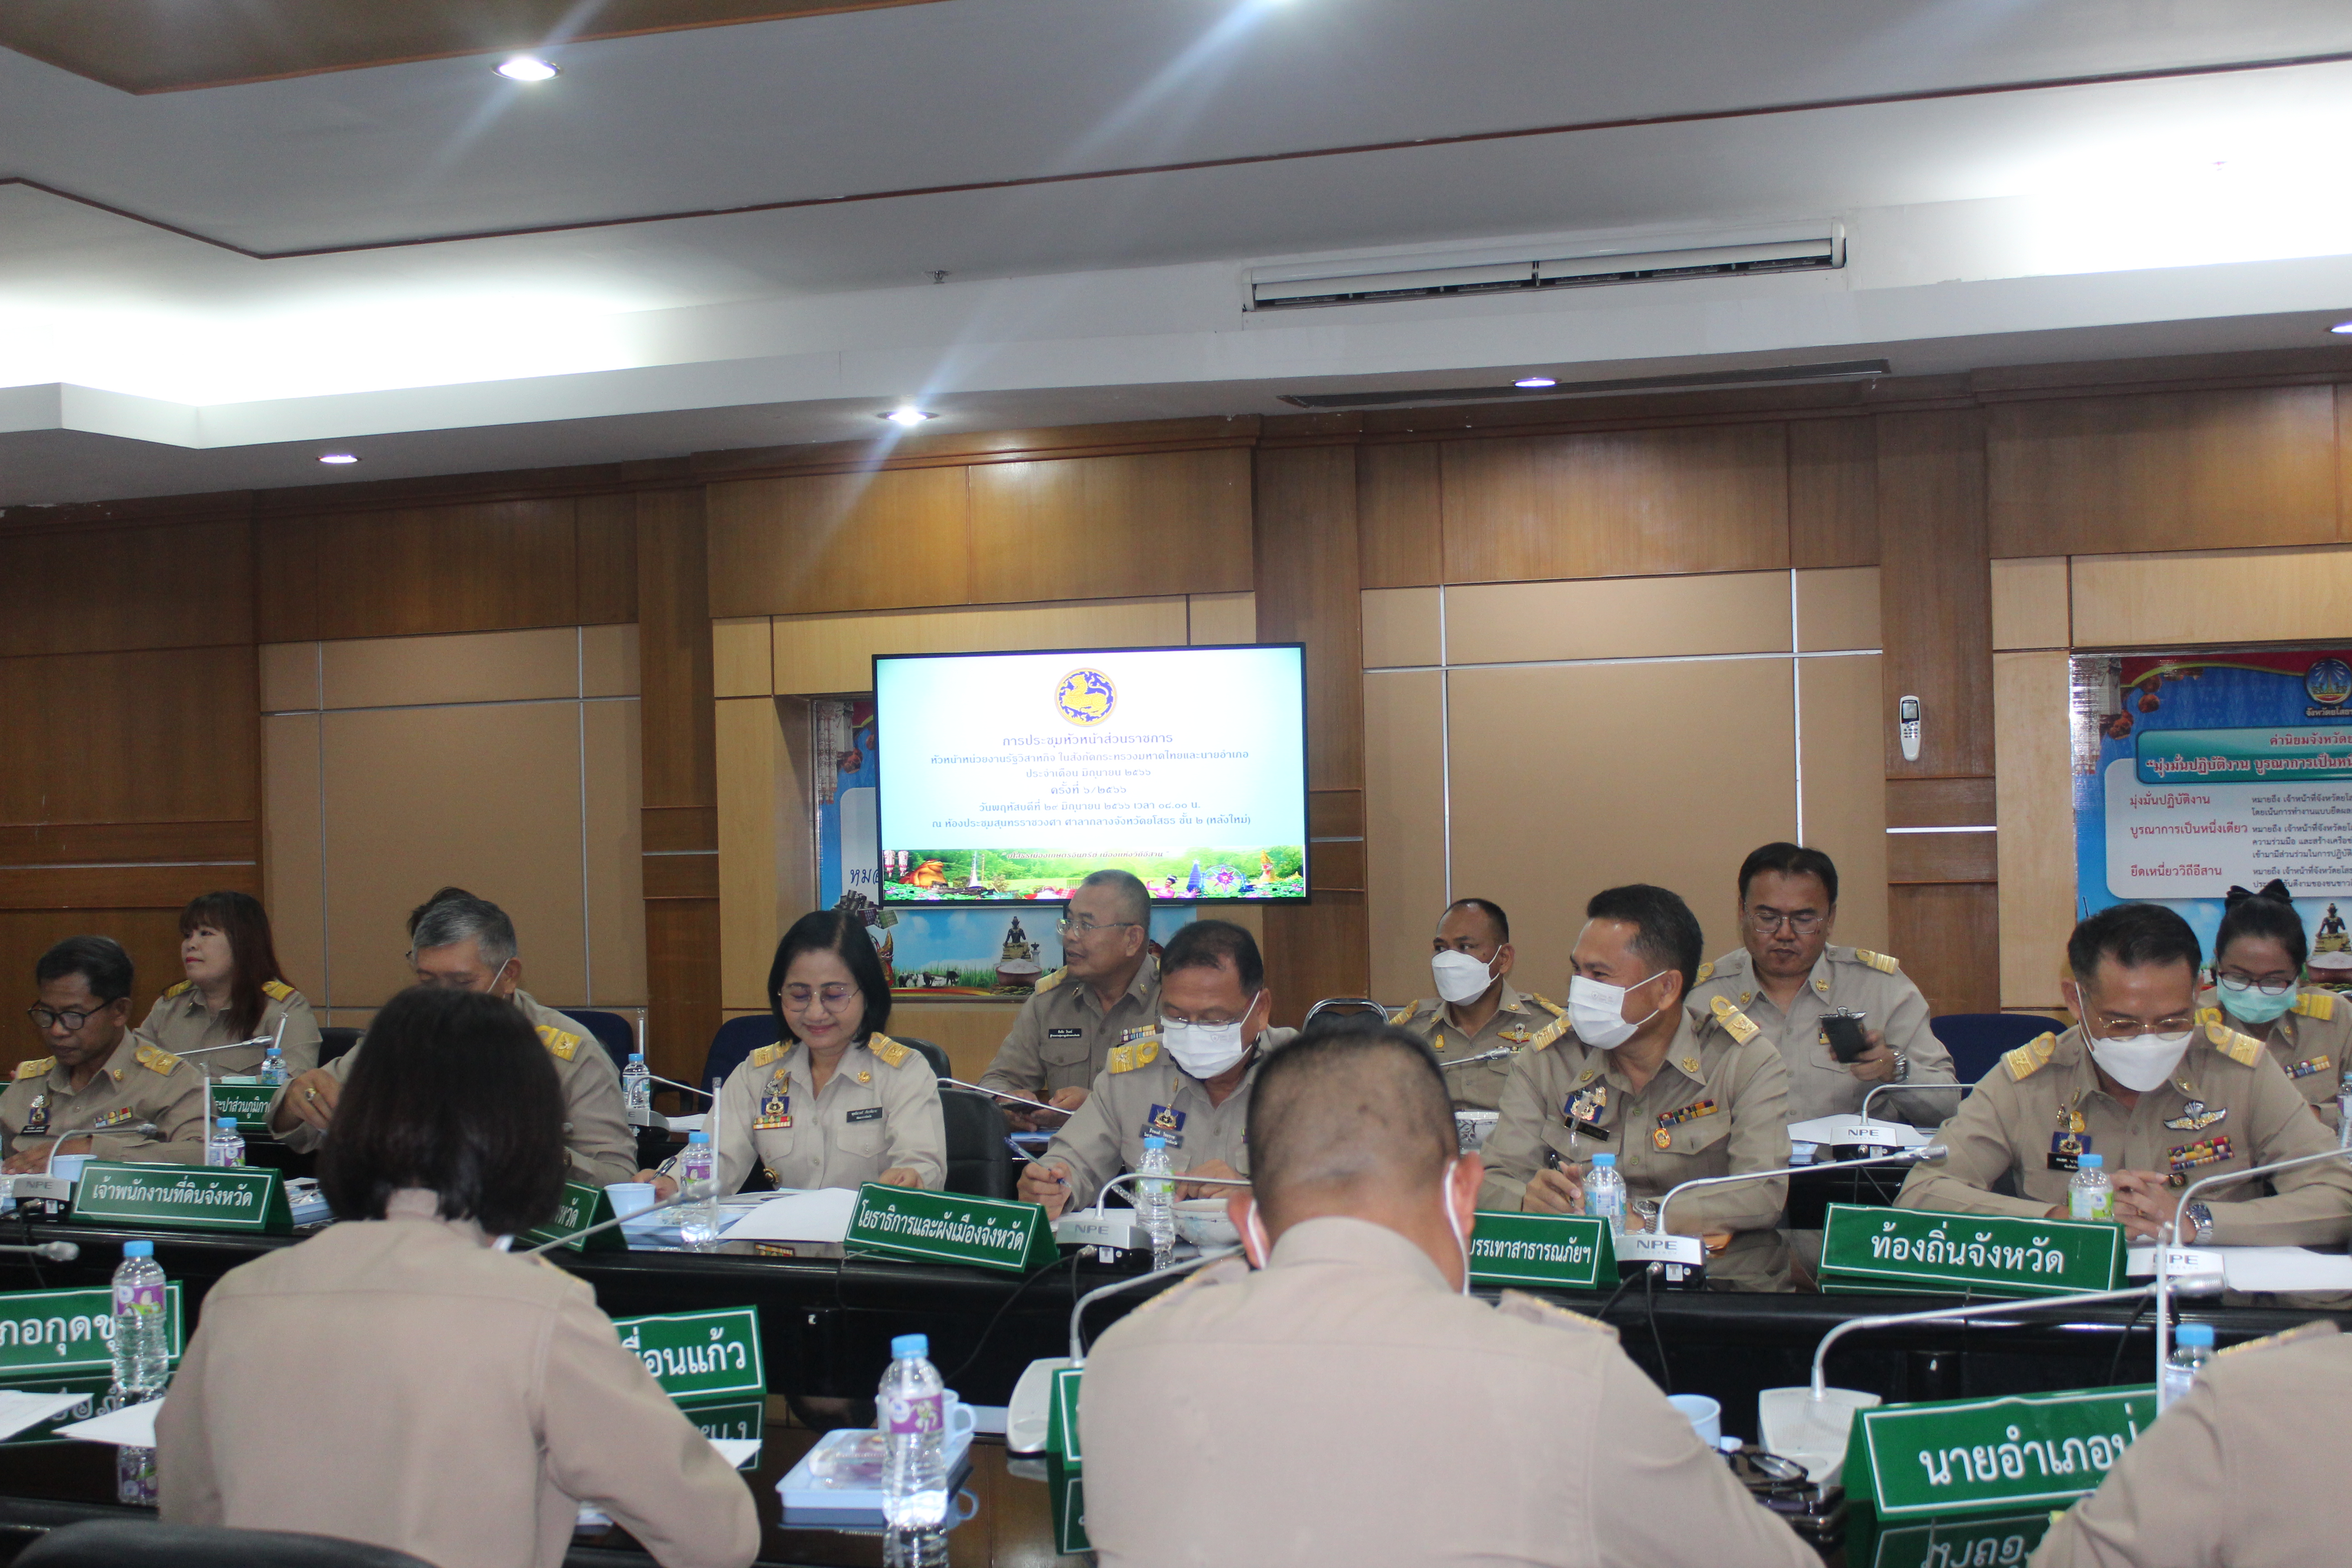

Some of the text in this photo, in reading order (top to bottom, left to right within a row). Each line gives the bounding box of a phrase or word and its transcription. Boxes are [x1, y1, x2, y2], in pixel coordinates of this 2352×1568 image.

[1003, 732, 1173, 748] การประชุมหัวหน้าส่วนราชการ
[931, 754, 1055, 764] หัวหน้าหน่วยงานรัฐวิสาหกิจ
[1026, 768, 1078, 778] ประจำเดือน
[1082, 768, 1121, 779] มิถุนายน
[1051, 781, 1079, 794] ครั้งที่
[2130, 791, 2210, 809] มุ่งมั่นปฏิบัติงาน
[2252, 794, 2280, 803] หมายถึง
[979, 799, 1040, 813] วันพฤหัสบดีที่
[1062, 802, 1100, 813] มิถุนายน
[1065, 815, 1176, 826] ศาลากลางจังหวัดยโสธร
[1179, 813, 1192, 824] ชั้น
[1206, 814, 1250, 826] (หลังใหม่)
[2130, 819, 2248, 838] บูรณาการเป็นหนึ่งเดียว
[2252, 822, 2352, 833] หมายถึง เจ้าหน้าที่จังหวัดยโ
[2131, 862, 2222, 876] ยึดเหนี่ยววิถีอีสาน
[2253, 867, 2280, 875] หมายถึง
[92, 1175, 253, 1206] เจ้าพนักงานที่ดินจังหวัด
[858, 1199, 1025, 1251] โยธาธิการและผังเมืองจังหวัด
[1074, 1224, 1109, 1235] NPE
[1637, 1240, 1677, 1250] NPE
[1871, 1220, 2064, 1274] ท้องถิ่นจังหวัด
[621, 1326, 746, 1377] ื่อนแก้ว
